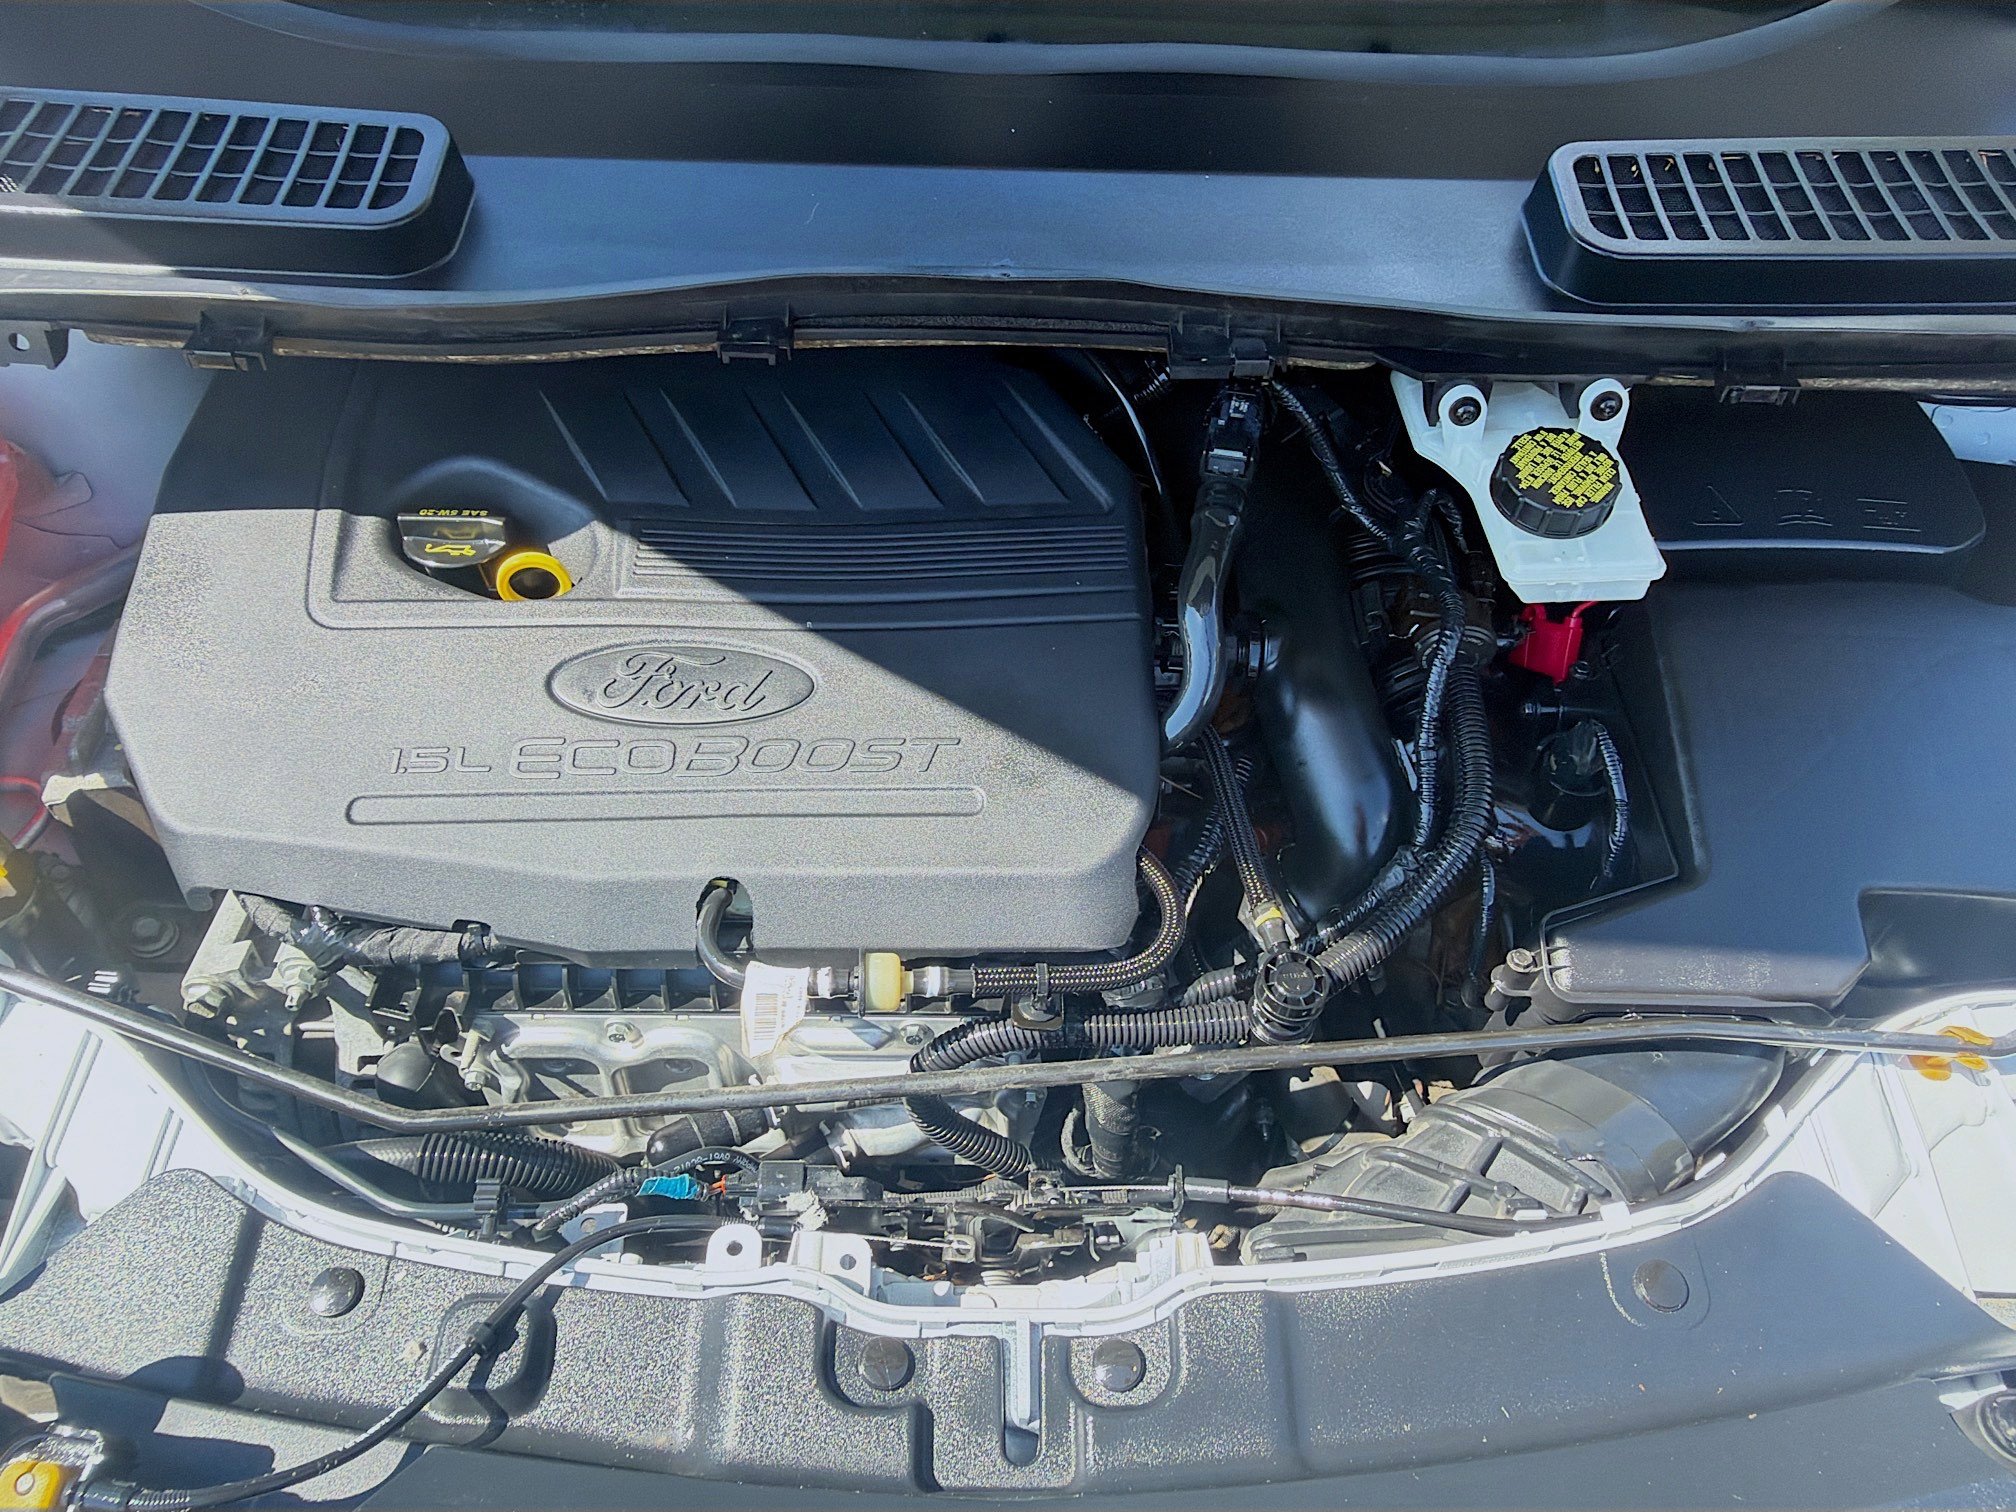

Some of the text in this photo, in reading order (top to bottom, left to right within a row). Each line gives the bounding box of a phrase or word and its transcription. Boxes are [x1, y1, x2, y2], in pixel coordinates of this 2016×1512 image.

[418, 508, 488, 517] SAE 5W-20
[598, 651, 773, 712] Ford
